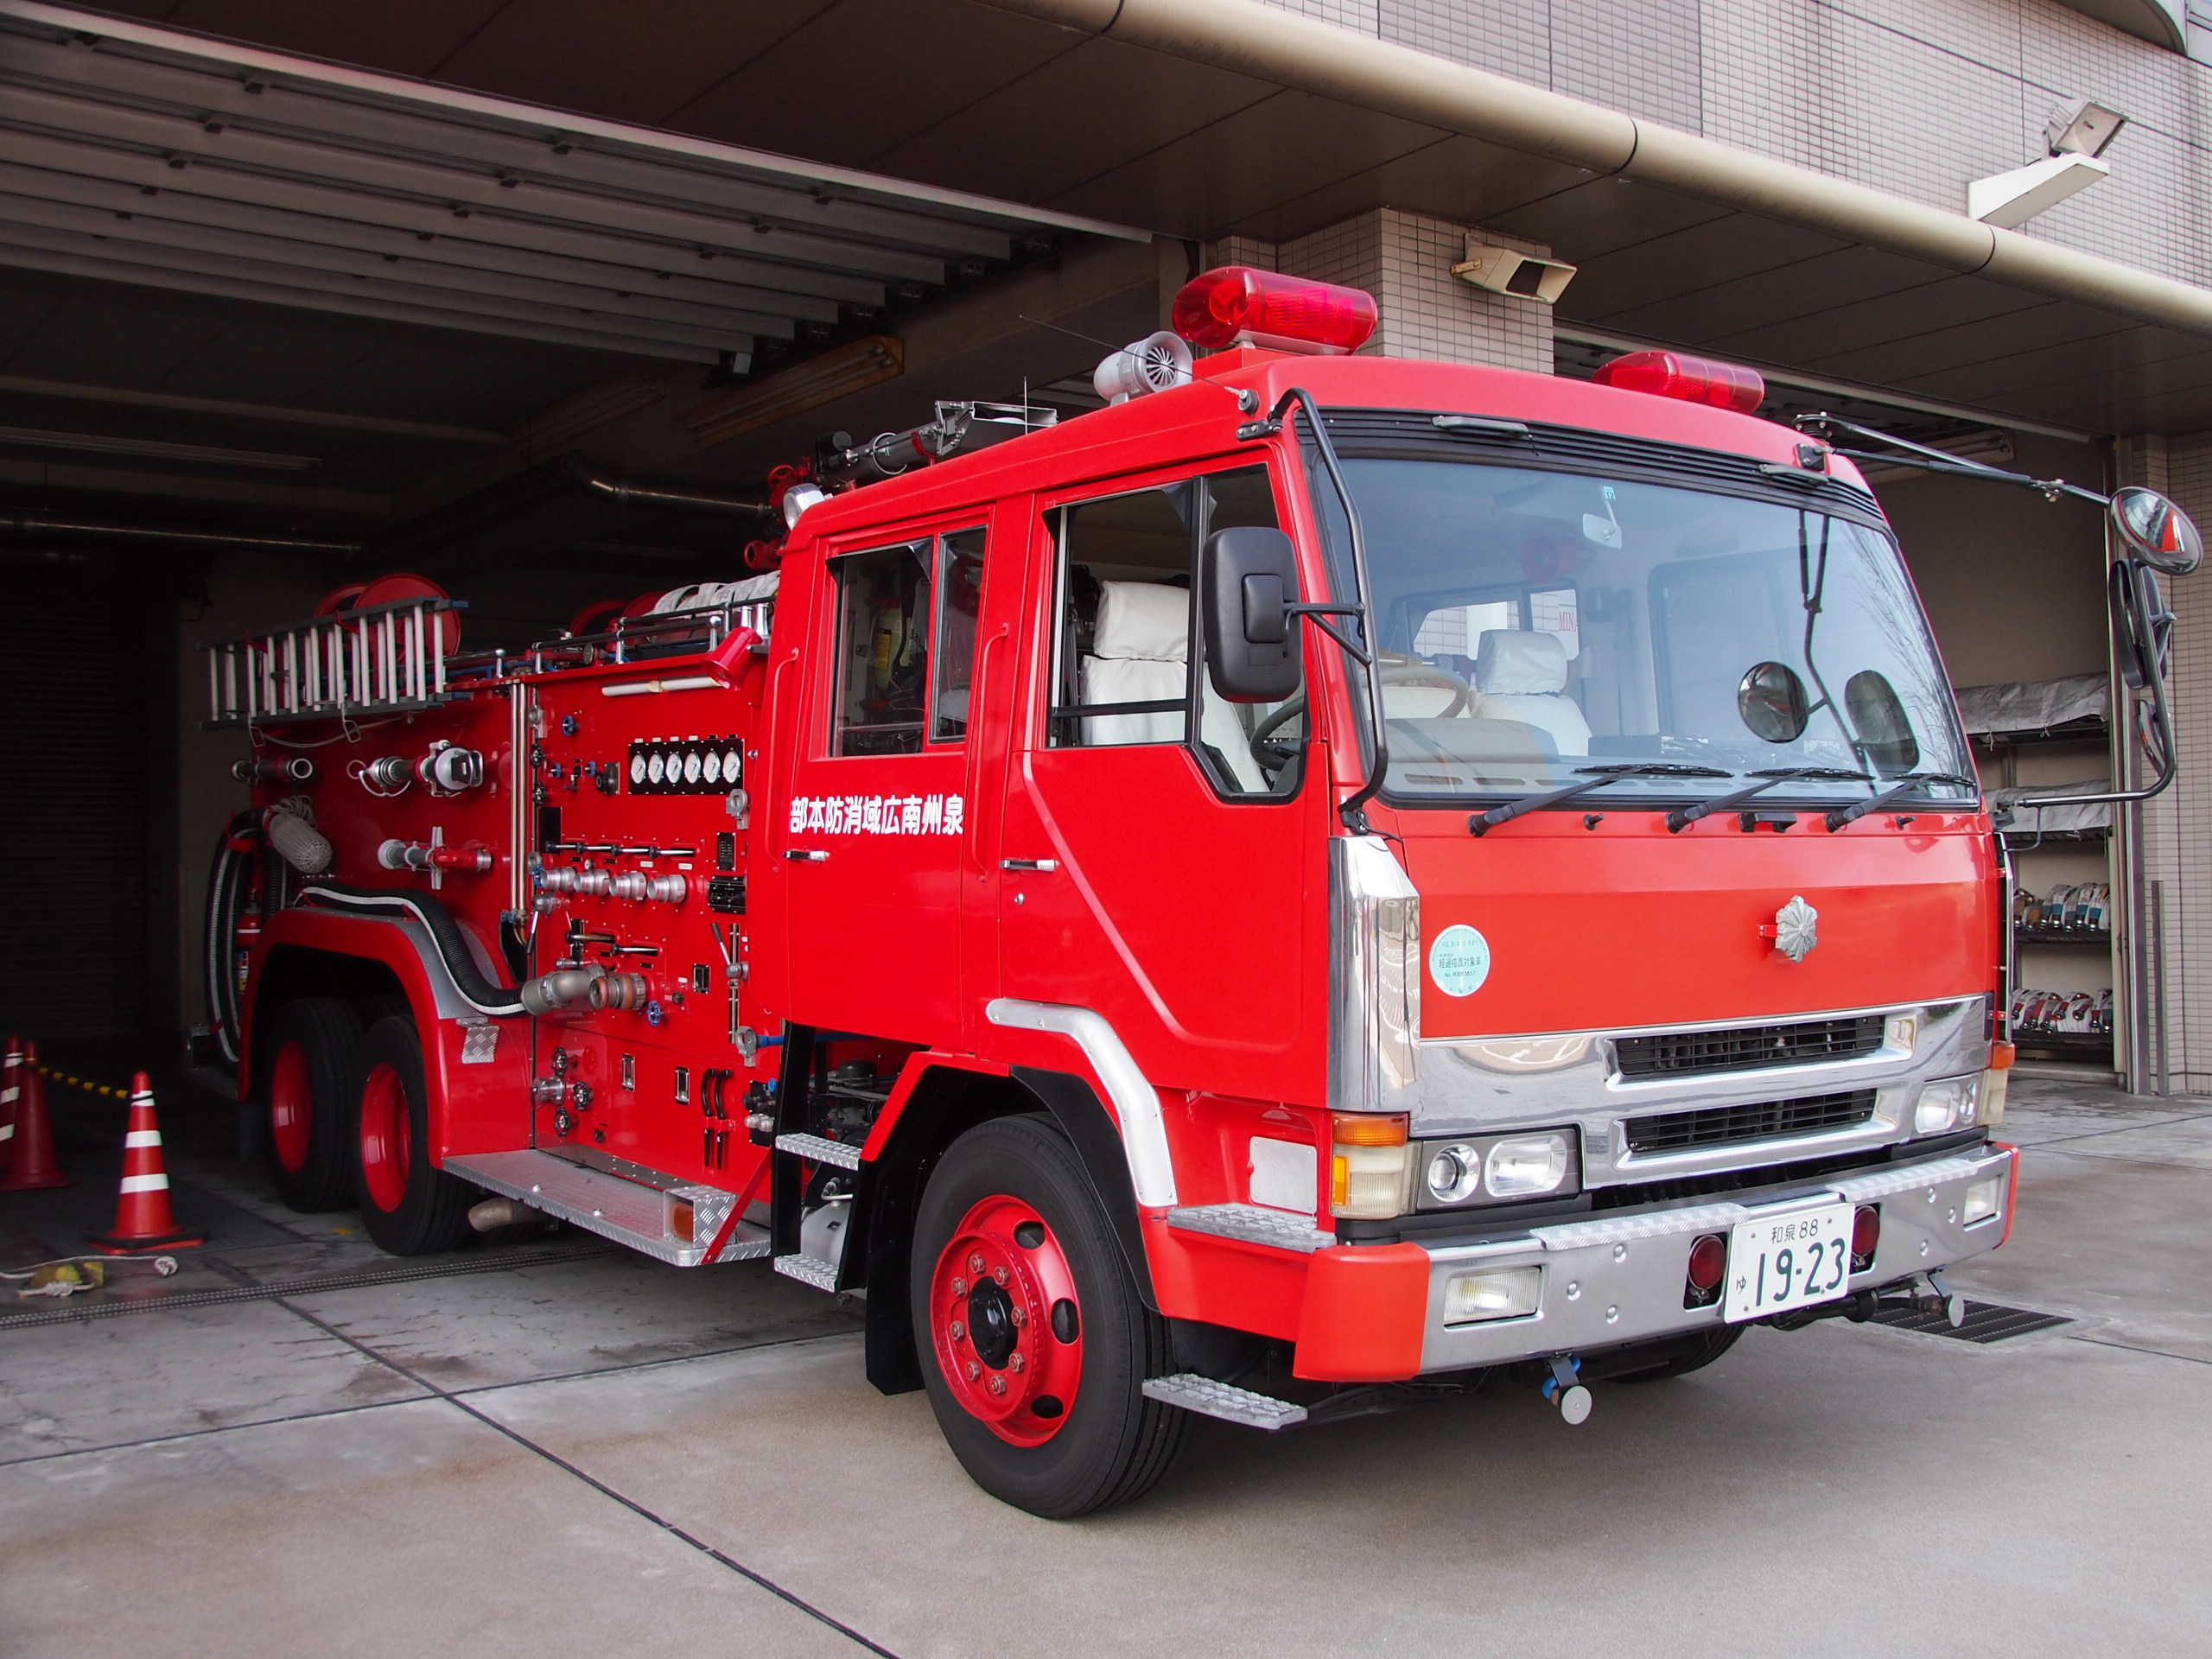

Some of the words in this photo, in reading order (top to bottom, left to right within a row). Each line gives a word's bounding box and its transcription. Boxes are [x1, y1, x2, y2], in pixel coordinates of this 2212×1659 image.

[1439, 957, 1483, 969] 経過措置対象車
[1756, 1237, 1846, 1306] 19-23
